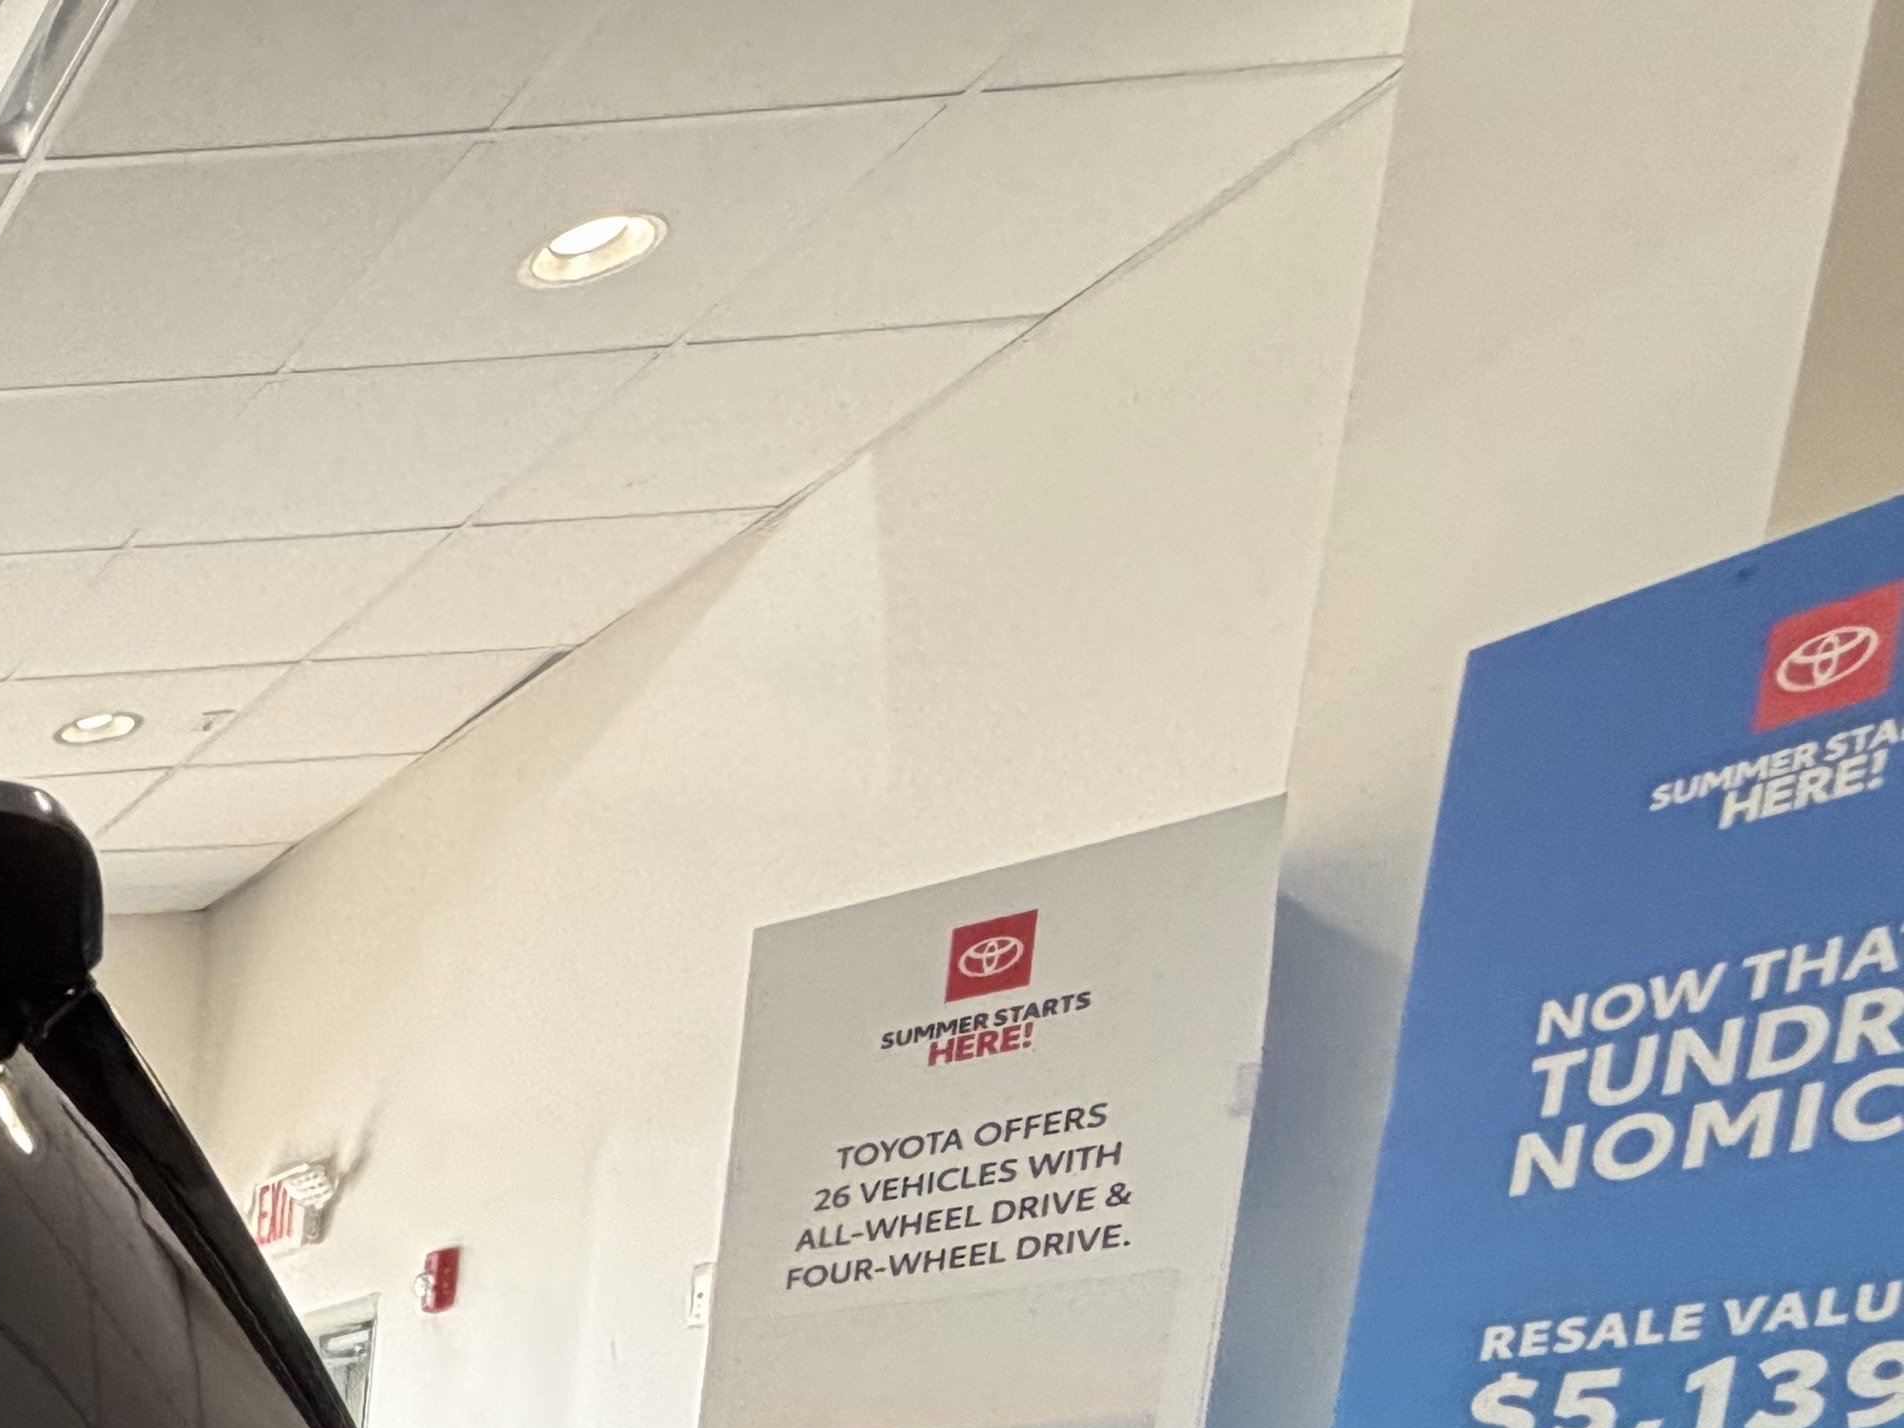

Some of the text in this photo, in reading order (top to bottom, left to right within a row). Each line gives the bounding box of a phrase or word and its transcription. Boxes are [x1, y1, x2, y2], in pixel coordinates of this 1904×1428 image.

[1649, 718, 1904, 811] SUMMER STA
[1717, 748, 1889, 830] HERE!
[1535, 921, 1904, 1045] NOW THA
[880, 991, 1092, 1050] SUMMER STARTS
[927, 1022, 1035, 1067] HERE!
[1531, 986, 1904, 1119] TUNDR
[837, 1102, 1109, 1170] TOYOTA OFFERS
[1508, 1066, 1904, 1197] NOMIC
[256, 1180, 293, 1244] EXIT
[812, 1141, 1123, 1213] 26 VEHICLES WITH
[794, 1182, 1133, 1253] ALL-WHEEL DRIVE &
[785, 1224, 1132, 1291] FOUR-WHEEL DRIVE.
[1479, 1279, 1904, 1362] RESALE VALU
